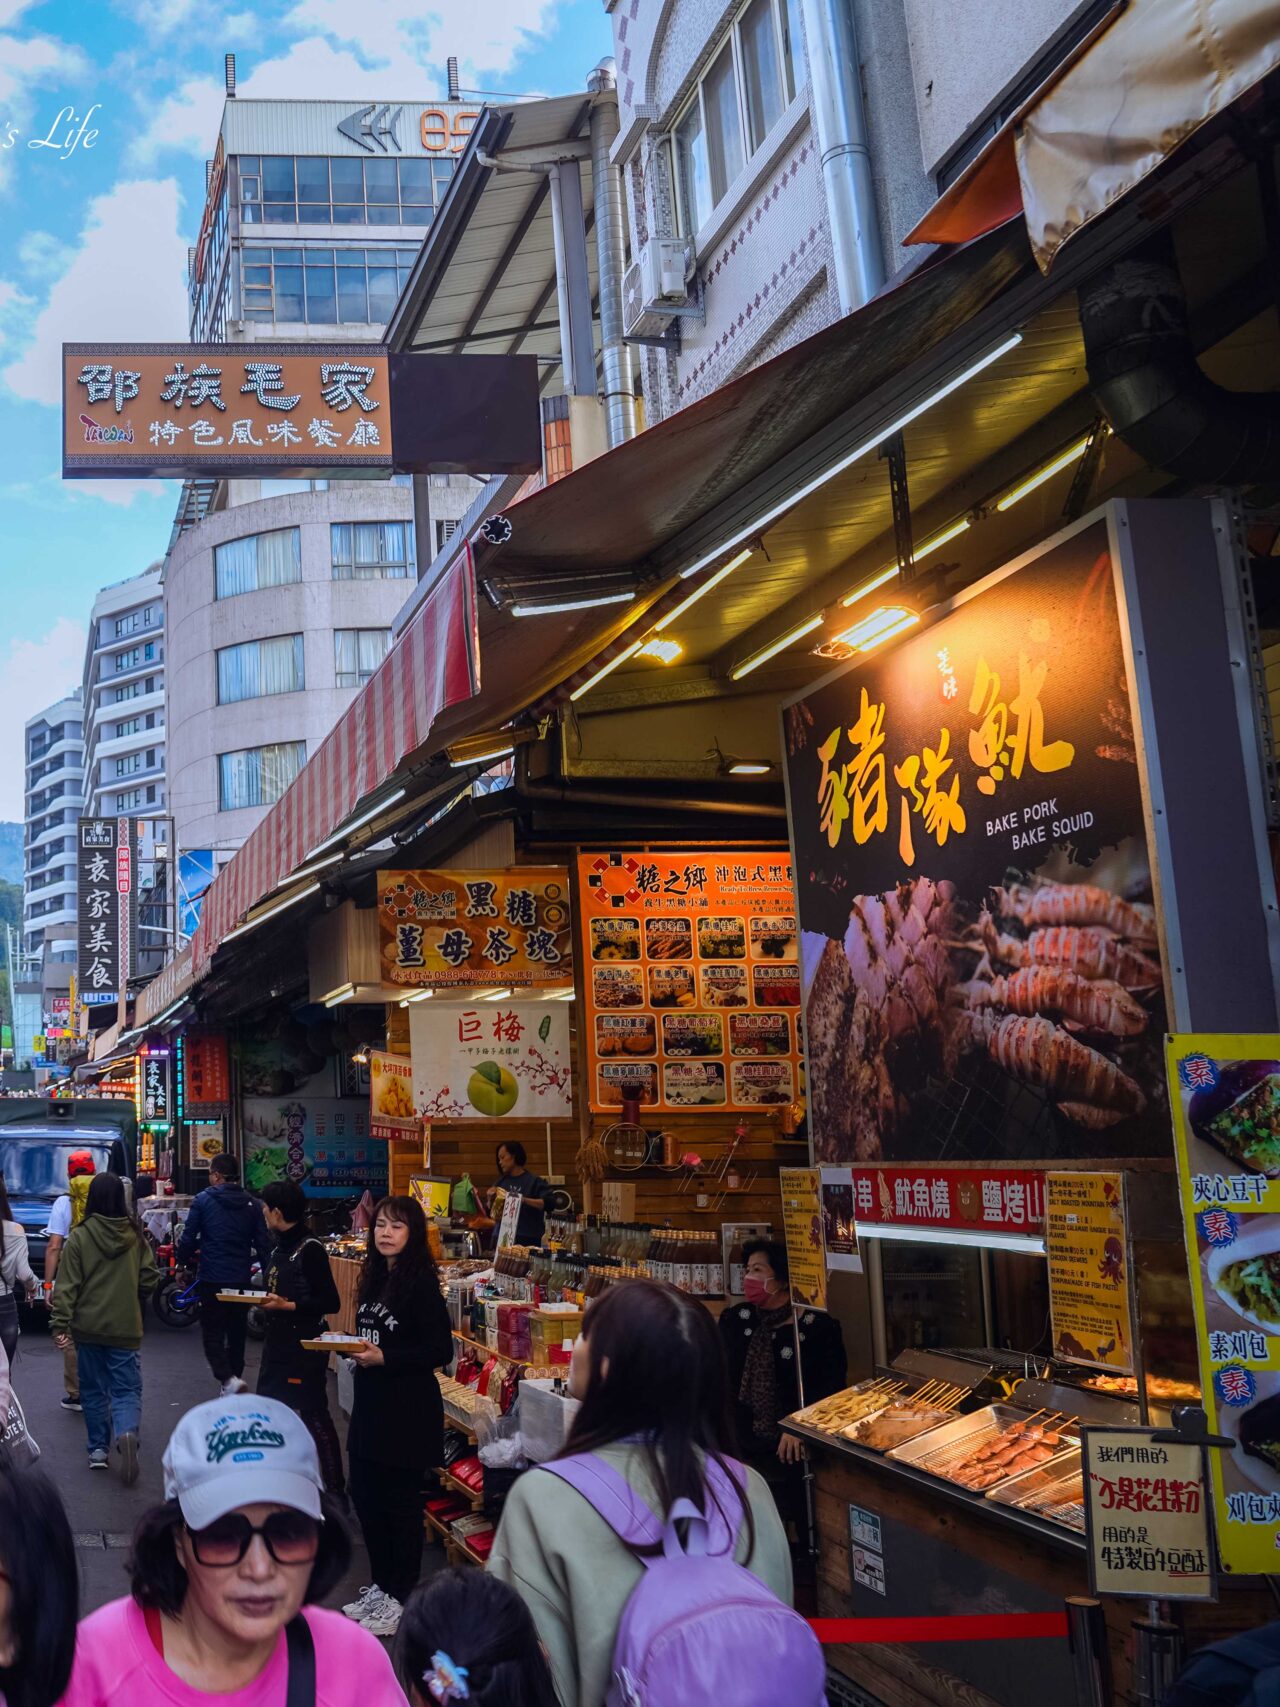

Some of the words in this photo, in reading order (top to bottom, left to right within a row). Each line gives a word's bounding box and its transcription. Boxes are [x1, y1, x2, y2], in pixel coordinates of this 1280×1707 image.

[78, 362, 380, 413] 邵族毛家
[149, 418, 380, 448] 特色風味餐廳
[986, 812, 1019, 836] BAKE
[1023, 798, 1058, 823] PORK
[1012, 826, 1046, 850] BAKE
[1052, 811, 1094, 837] SQUID
[635, 864, 708, 895] 糖之鄉
[466, 881, 536, 926] 黑糖
[84, 852, 113, 989] 袁家美食
[397, 923, 562, 966] 薑母茶塊
[458, 1010, 525, 1043] 巨梅
[665, 1016, 719, 1028] 黑糖葡萄籽
[146, 1061, 160, 1086] 袁家
[671, 1065, 717, 1077] 黑糖冬瓜
[1185, 1058, 1215, 1088] 素
[156, 1086, 167, 1106] 美食
[287, 1113, 306, 1178] 經濟合菜
[893, 1178, 951, 1220] 魷魚燒
[1192, 1175, 1268, 1203] 夾心豆干
[1203, 1212, 1233, 1243] 素
[1209, 1333, 1269, 1361] 素刈包
[1220, 1369, 1251, 1401] 素
[1097, 1445, 1169, 1464] 我們用的
[1102, 1526, 1153, 1545] 用的是
[1101, 1546, 1209, 1573] 特製的豆酥
